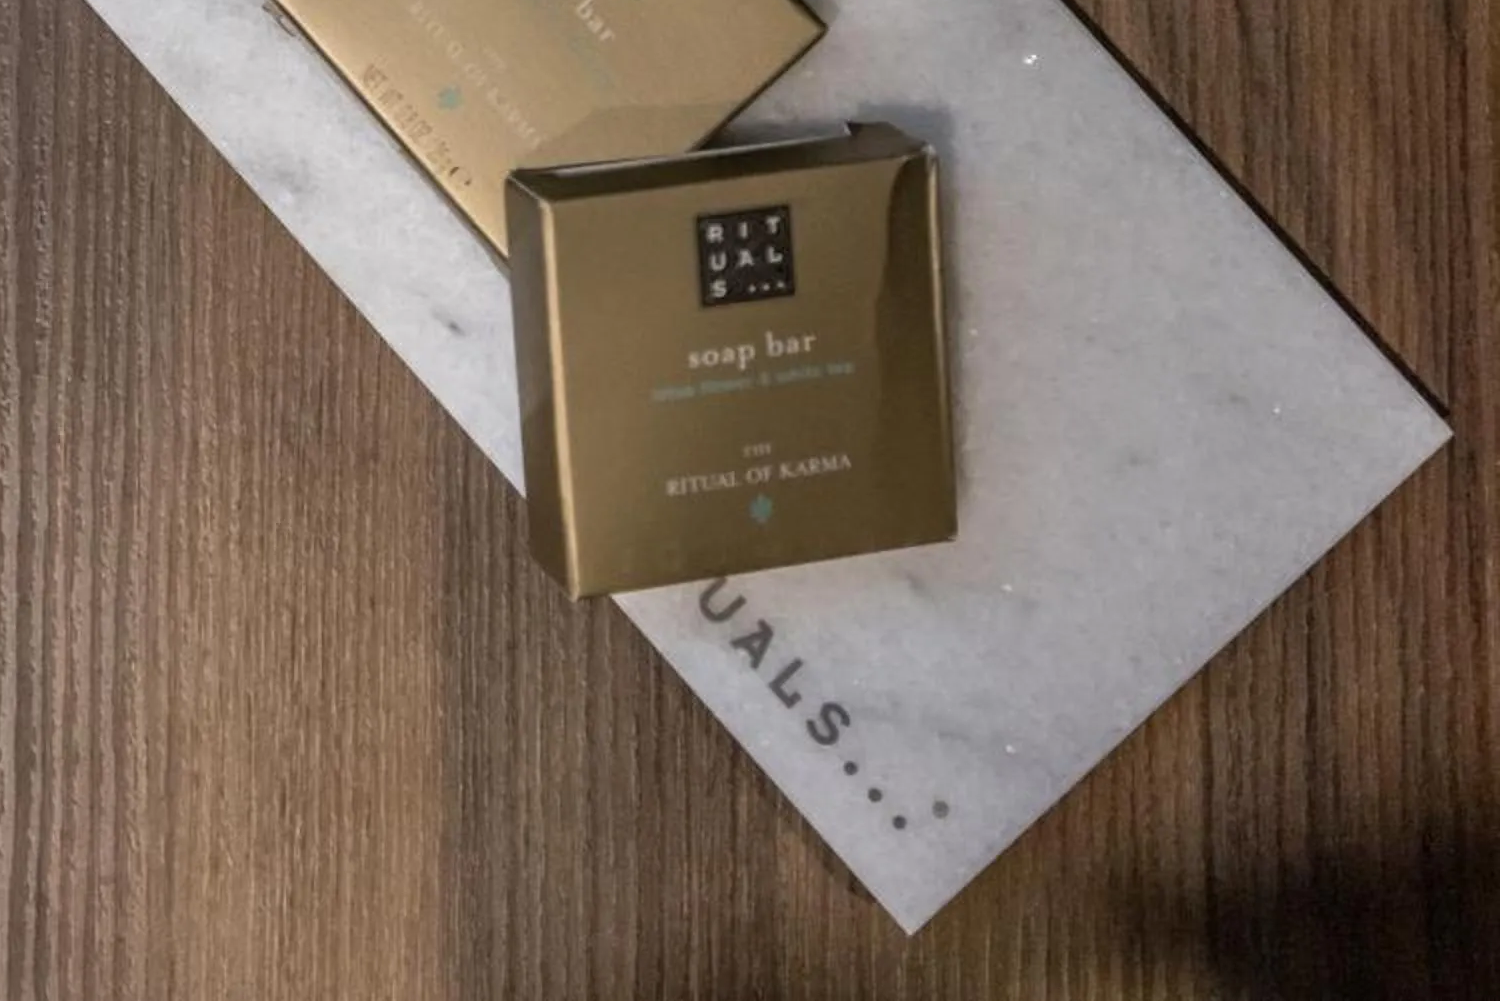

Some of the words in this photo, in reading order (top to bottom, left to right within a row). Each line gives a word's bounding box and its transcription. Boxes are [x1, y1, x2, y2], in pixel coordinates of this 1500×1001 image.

[688, 344, 756, 371] soap
[764, 330, 817, 358] bar
[665, 470, 739, 496] RITUAL
[778, 453, 852, 480] KARMA
